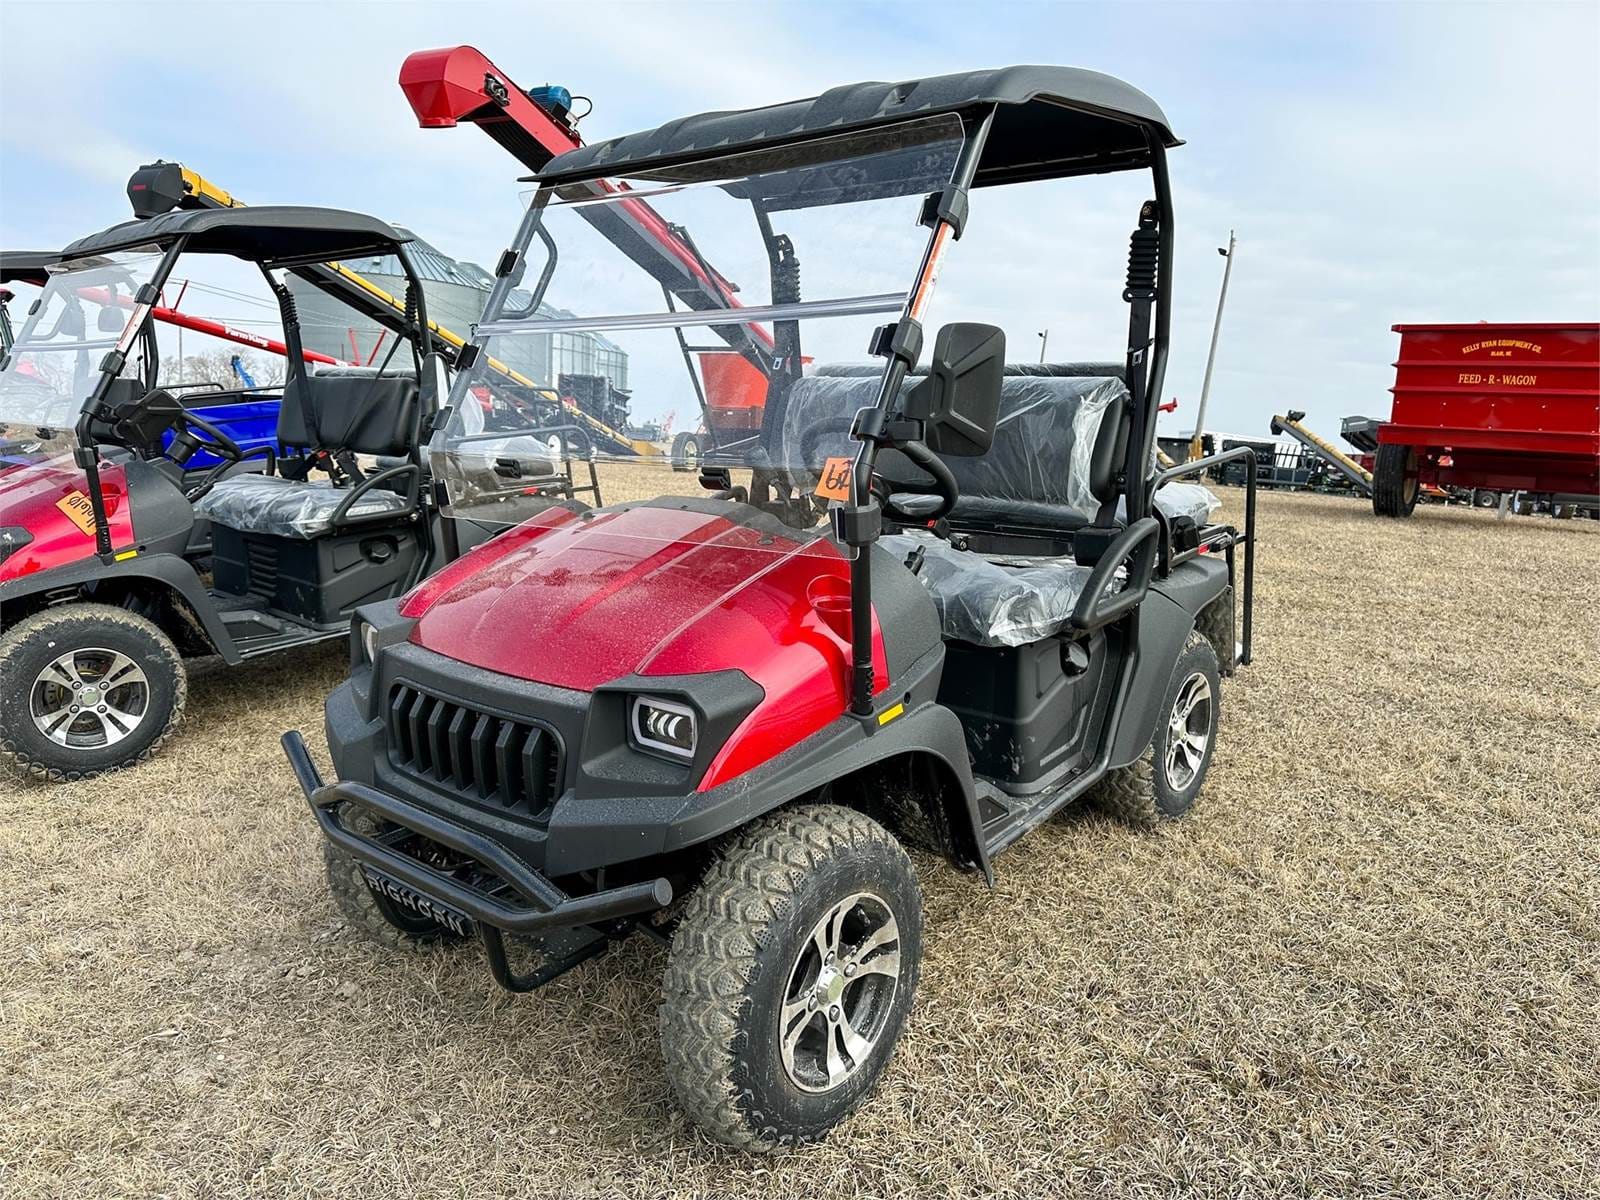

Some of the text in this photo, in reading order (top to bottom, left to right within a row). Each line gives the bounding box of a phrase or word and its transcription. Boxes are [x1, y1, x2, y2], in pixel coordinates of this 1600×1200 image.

[1462, 342, 1480, 354] KELLY
[1481, 339, 1497, 349] RYAN
[1498, 339, 1533, 350] EQUIPMENT
[1458, 373, 1481, 384] FEED
[1488, 374, 1495, 385] R
[1502, 374, 1537, 386] WAGON
